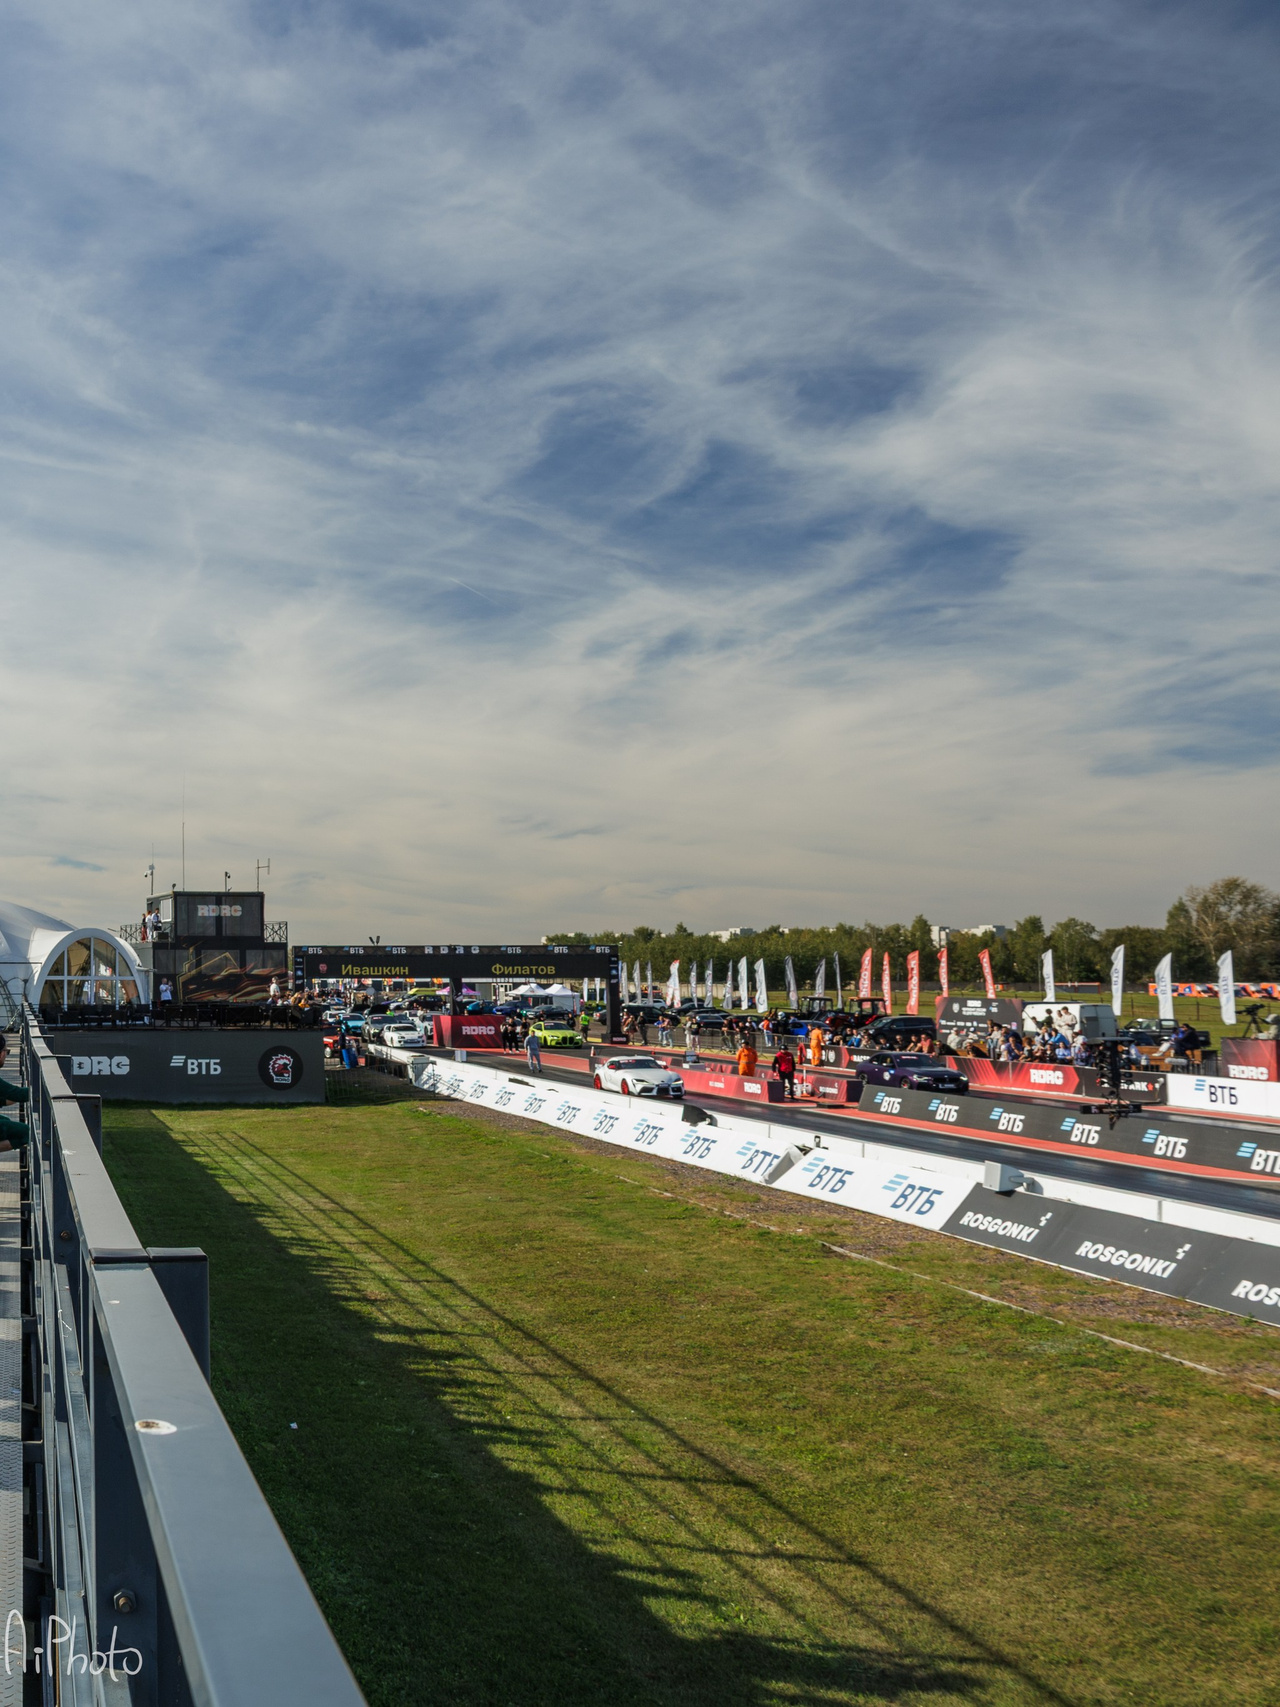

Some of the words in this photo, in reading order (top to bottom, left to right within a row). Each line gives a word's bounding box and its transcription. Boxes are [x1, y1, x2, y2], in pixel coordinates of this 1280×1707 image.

[197, 905, 242, 916] RDRC
[554, 946, 568, 954] ВТБ
[341, 964, 409, 975] Ивашкин
[491, 963, 556, 975] Филатов
[462, 1026, 495, 1035] RDRC
[71, 1055, 130, 1075] DRC
[187, 1059, 221, 1074] ВТБ
[1227, 1064, 1269, 1080] RDRC
[1029, 1069, 1064, 1085] RDRC
[495, 1091, 515, 1106] ВТБ
[1209, 1084, 1238, 1105] ВТБ
[524, 1097, 547, 1113] ВТБ
[880, 1097, 902, 1114] ВТБ
[935, 1104, 959, 1122] ВТБ
[556, 1105, 581, 1124] ВТБ
[593, 1114, 620, 1134] ВТБ
[998, 1115, 1025, 1133] ВТБ
[634, 1124, 664, 1145] ВТБ
[1070, 1124, 1101, 1145] ВТБ
[682, 1135, 718, 1159] ВТБ
[1154, 1135, 1189, 1158] ВТБ
[807, 1165, 855, 1193] ВТБ
[890, 1183, 944, 1216] ВТБ
[959, 1211, 1040, 1243] ROSGONKI
[1075, 1241, 1177, 1279] ROSGONKI
[1231, 1279, 1280, 1306] ROS
